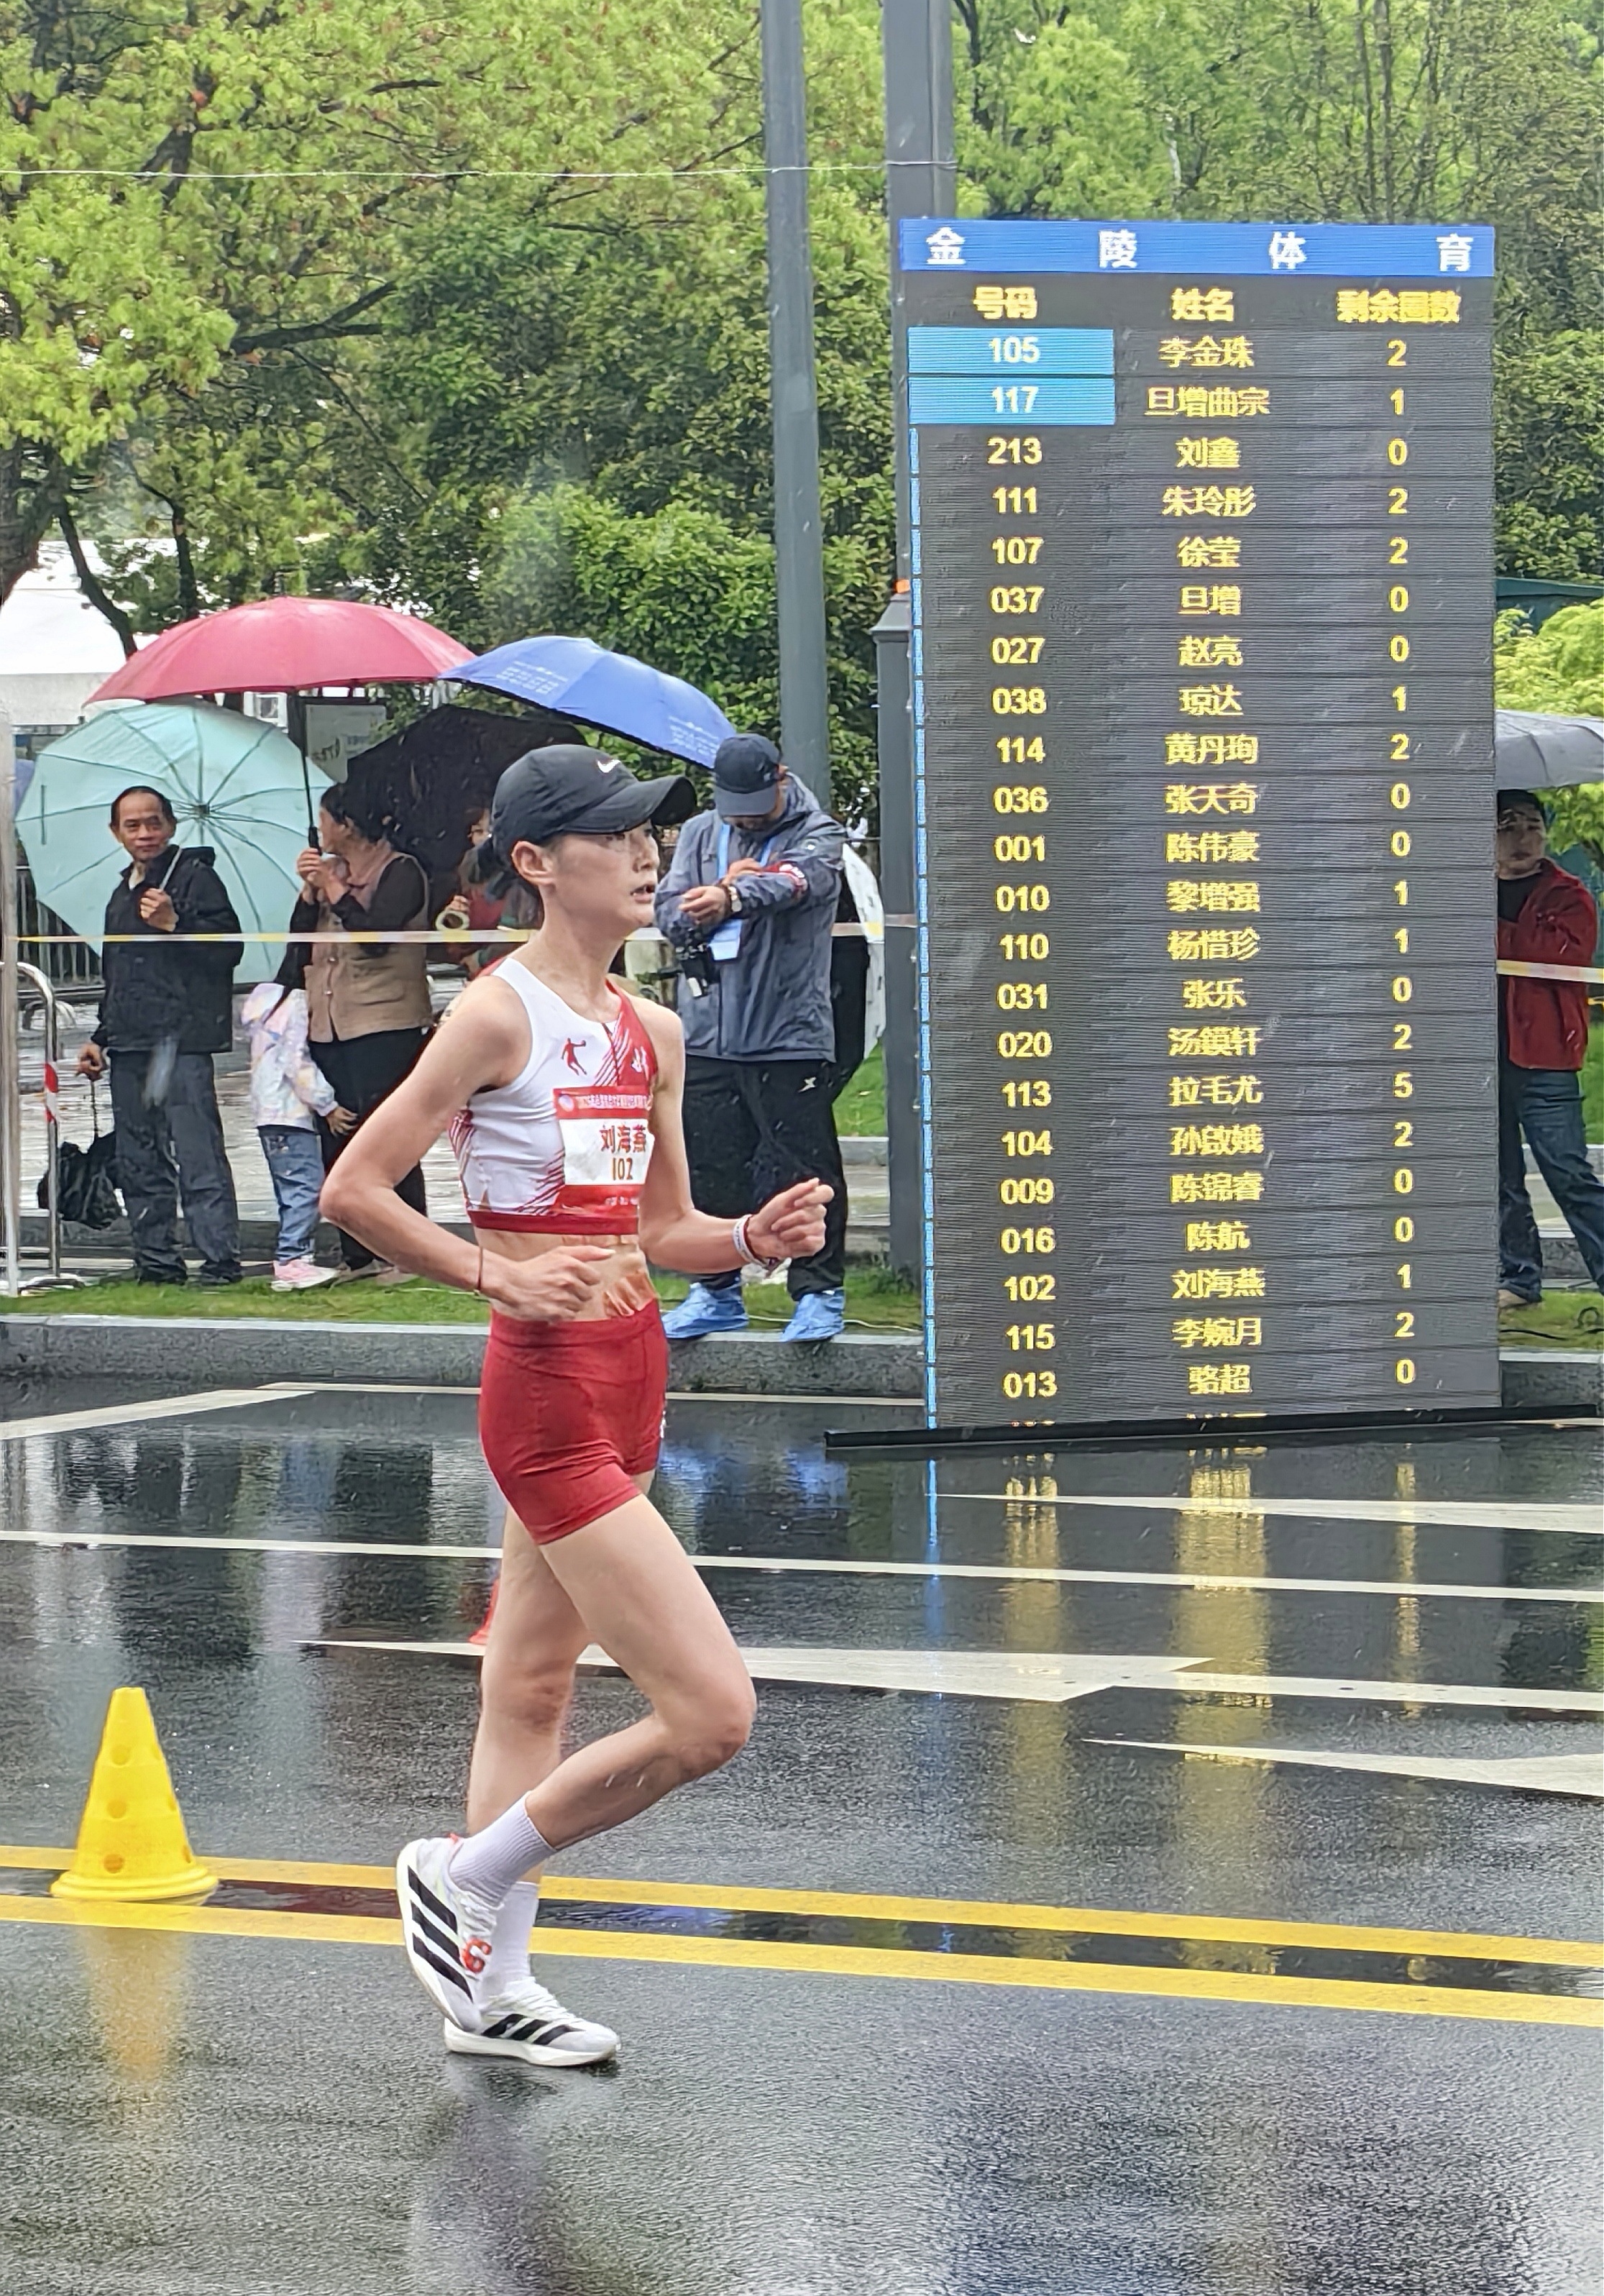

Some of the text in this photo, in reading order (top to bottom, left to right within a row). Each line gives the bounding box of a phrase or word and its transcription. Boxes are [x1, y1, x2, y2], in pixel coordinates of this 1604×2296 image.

[925, 227, 1474, 272] 金陵体育
[971, 285, 1460, 324] 号码 姓名 剩余圈数
[988, 335, 1406, 367] 105 李金珠 2
[991, 385, 1403, 418] 117 旦增曲宗 1
[986, 436, 1040, 465] 213
[1386, 437, 1407, 466] 0
[992, 486, 1037, 513] 111
[1388, 486, 1407, 515] 2
[991, 536, 1408, 568] 107 徐莹 2
[989, 585, 1409, 616] 037 旦增 0
[991, 634, 1409, 667] 027 赵亮 0
[991, 684, 1406, 716] 038 琼达 1
[995, 736, 1045, 763] 114
[1390, 733, 1408, 760] 2
[992, 782, 1410, 815] 036 张天奇 0
[993, 831, 1409, 864] 001 陈伟豪 0
[994, 884, 1050, 913] 010
[1394, 880, 1407, 905] 1
[999, 927, 1408, 961] 110 杨惜珍 1
[996, 977, 1411, 1010] 031 张乐 0
[996, 1030, 1053, 1058] 020
[1392, 1023, 1411, 1051] 2
[1001, 1071, 1413, 1108] 113 拉毛尤 5
[1001, 1129, 1053, 1158] 104
[1393, 1121, 1411, 1147] 2
[611, 1157, 633, 1181] 102
[999, 1177, 1055, 1205] 009
[1393, 1168, 1413, 1194] 0
[1000, 1217, 1413, 1254] 016 陈航 0
[1003, 1263, 1409, 1302] 102 刘海燕 1
[1005, 1323, 1055, 1351] 115
[1394, 1311, 1413, 1338] 2
[1002, 1371, 1058, 1399] 013
[1394, 1358, 1415, 1384] 0
